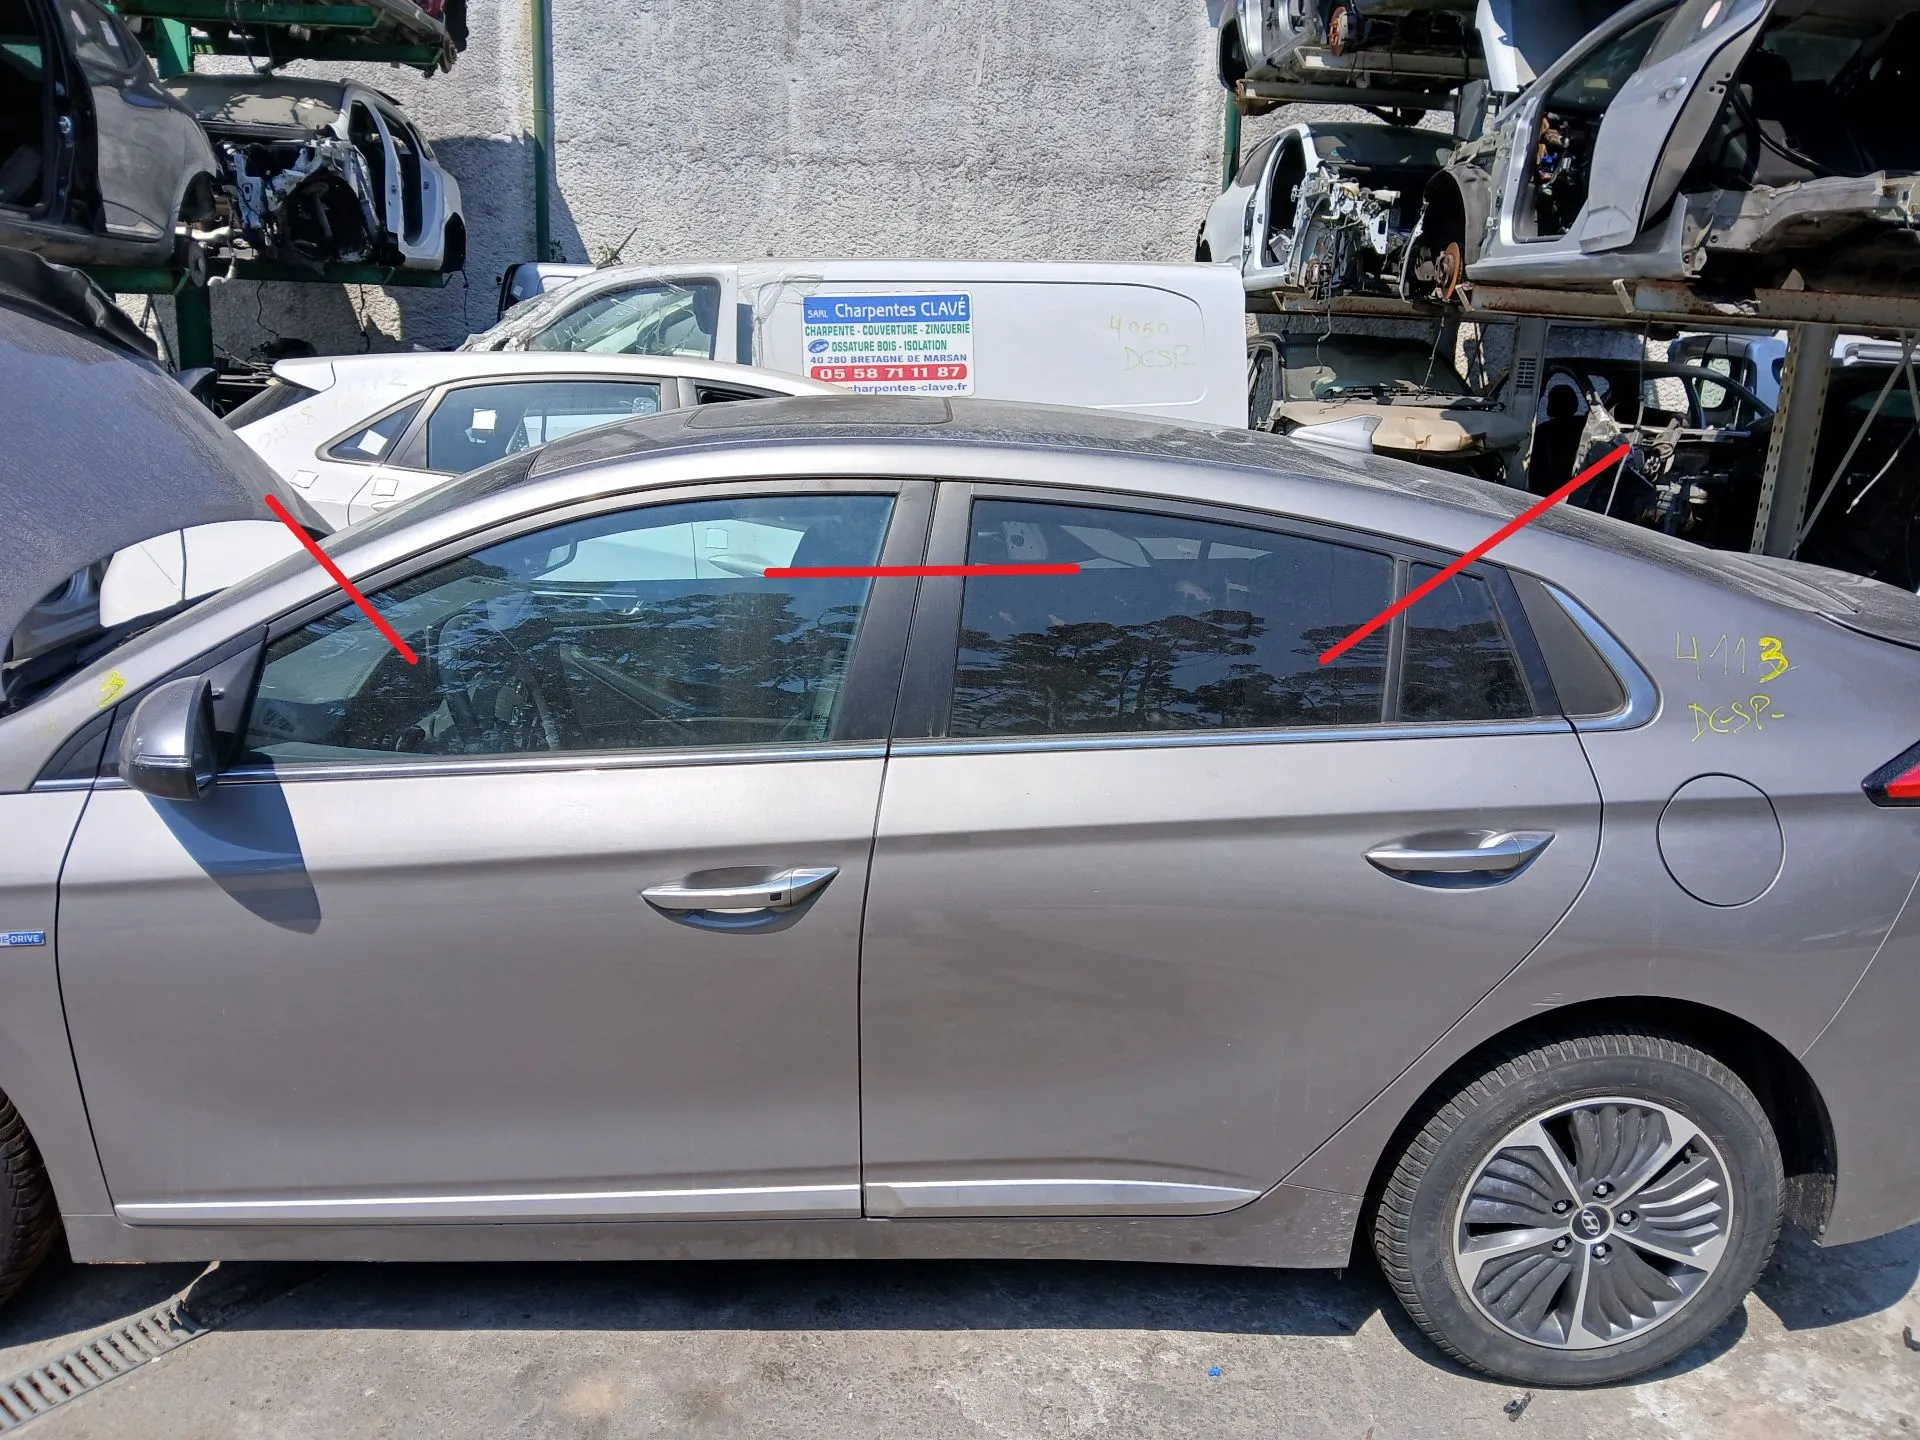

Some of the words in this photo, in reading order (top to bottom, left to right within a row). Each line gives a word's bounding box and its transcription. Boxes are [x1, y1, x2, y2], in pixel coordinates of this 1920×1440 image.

[807, 310, 829, 319] SARL
[834, 303, 917, 321] Charpentes
[920, 296, 967, 317] CLAVÉ
[805, 325, 855, 337] CHARPENTE
[862, 324, 918, 336] COUVERTURE
[925, 323, 970, 335] ZINGUERIE
[831, 341, 875, 352] OSSATURE
[877, 340, 897, 351] BOIS
[904, 340, 947, 351] ISOLATION
[810, 356, 824, 364] 40
[827, 356, 847, 364] 280
[850, 355, 903, 363] BRETAGNE
[907, 355, 920, 363] DE
[924, 354, 967, 362] MARSAN
[819, 368, 846, 379] 05
[853, 368, 878, 379] 58
[885, 367, 904, 378] 71
[911, 367, 928, 377] 11
[937, 366, 960, 377] 87
[0, 934, 40, 943] E-DRIVE
